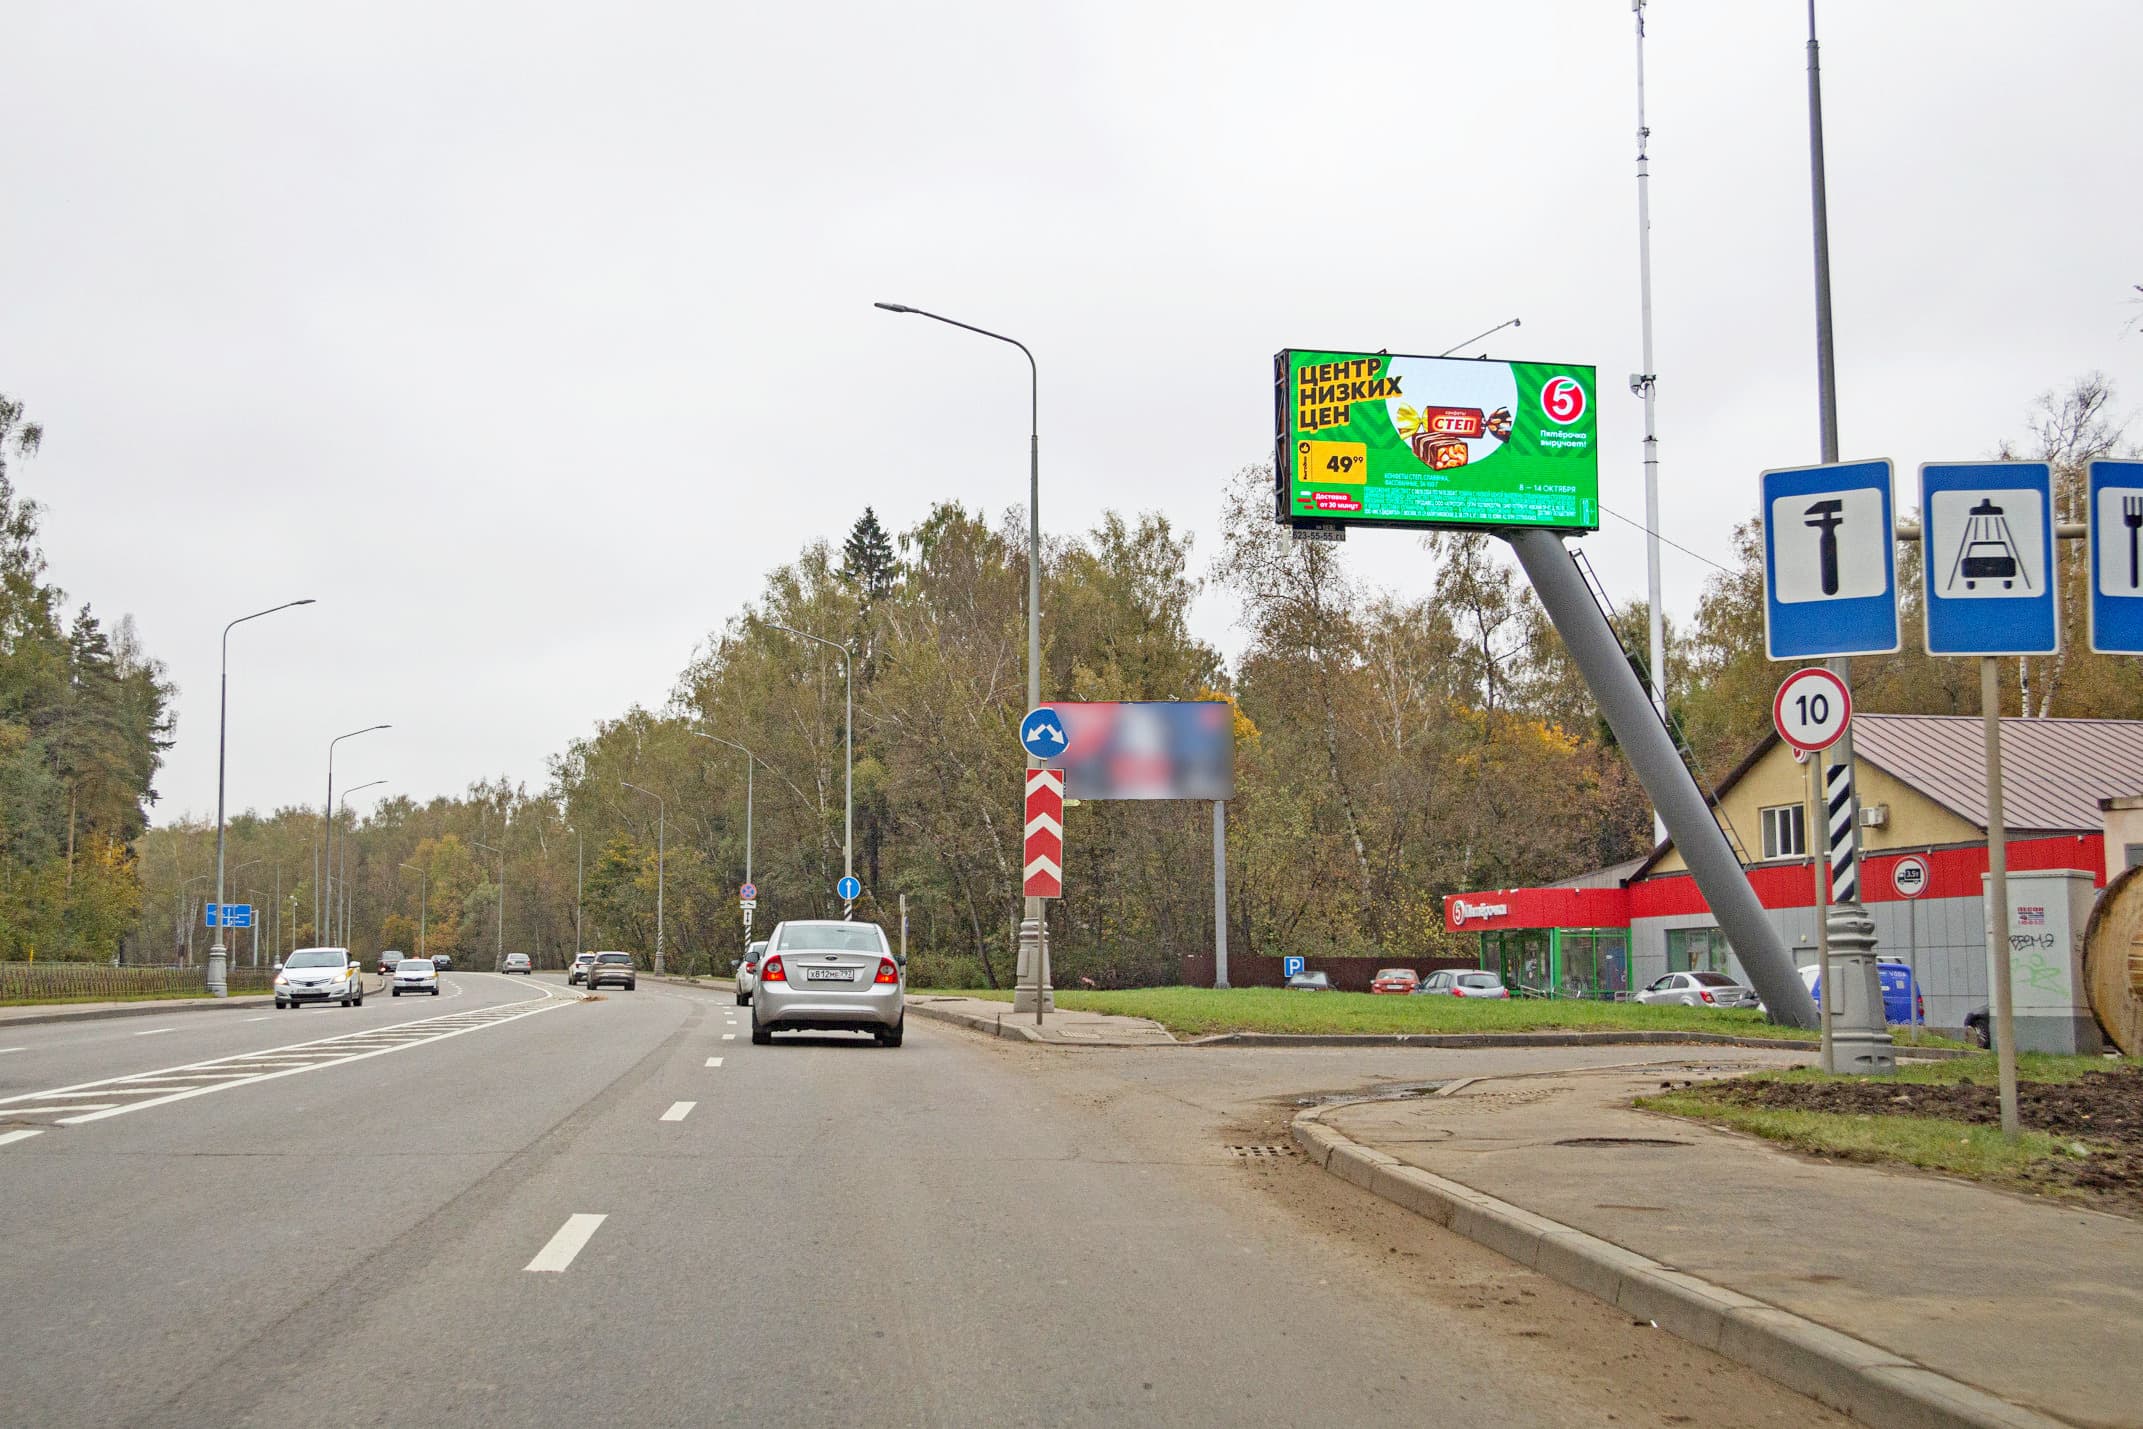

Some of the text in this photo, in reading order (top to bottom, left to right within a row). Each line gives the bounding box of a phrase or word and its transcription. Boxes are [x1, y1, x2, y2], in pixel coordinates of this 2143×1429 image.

[1299, 358, 1382, 386] ЦЕНТР
[1299, 375, 1403, 406] НИЗКИХ
[1299, 404, 1350, 430] ЦЕН
[1434, 418, 1475, 431] СТЕП
[1315, 493, 1348, 501] Доставка
[1543, 485, 1576, 493] ОКТЯБРЯ
[1796, 694, 1829, 726] 10
